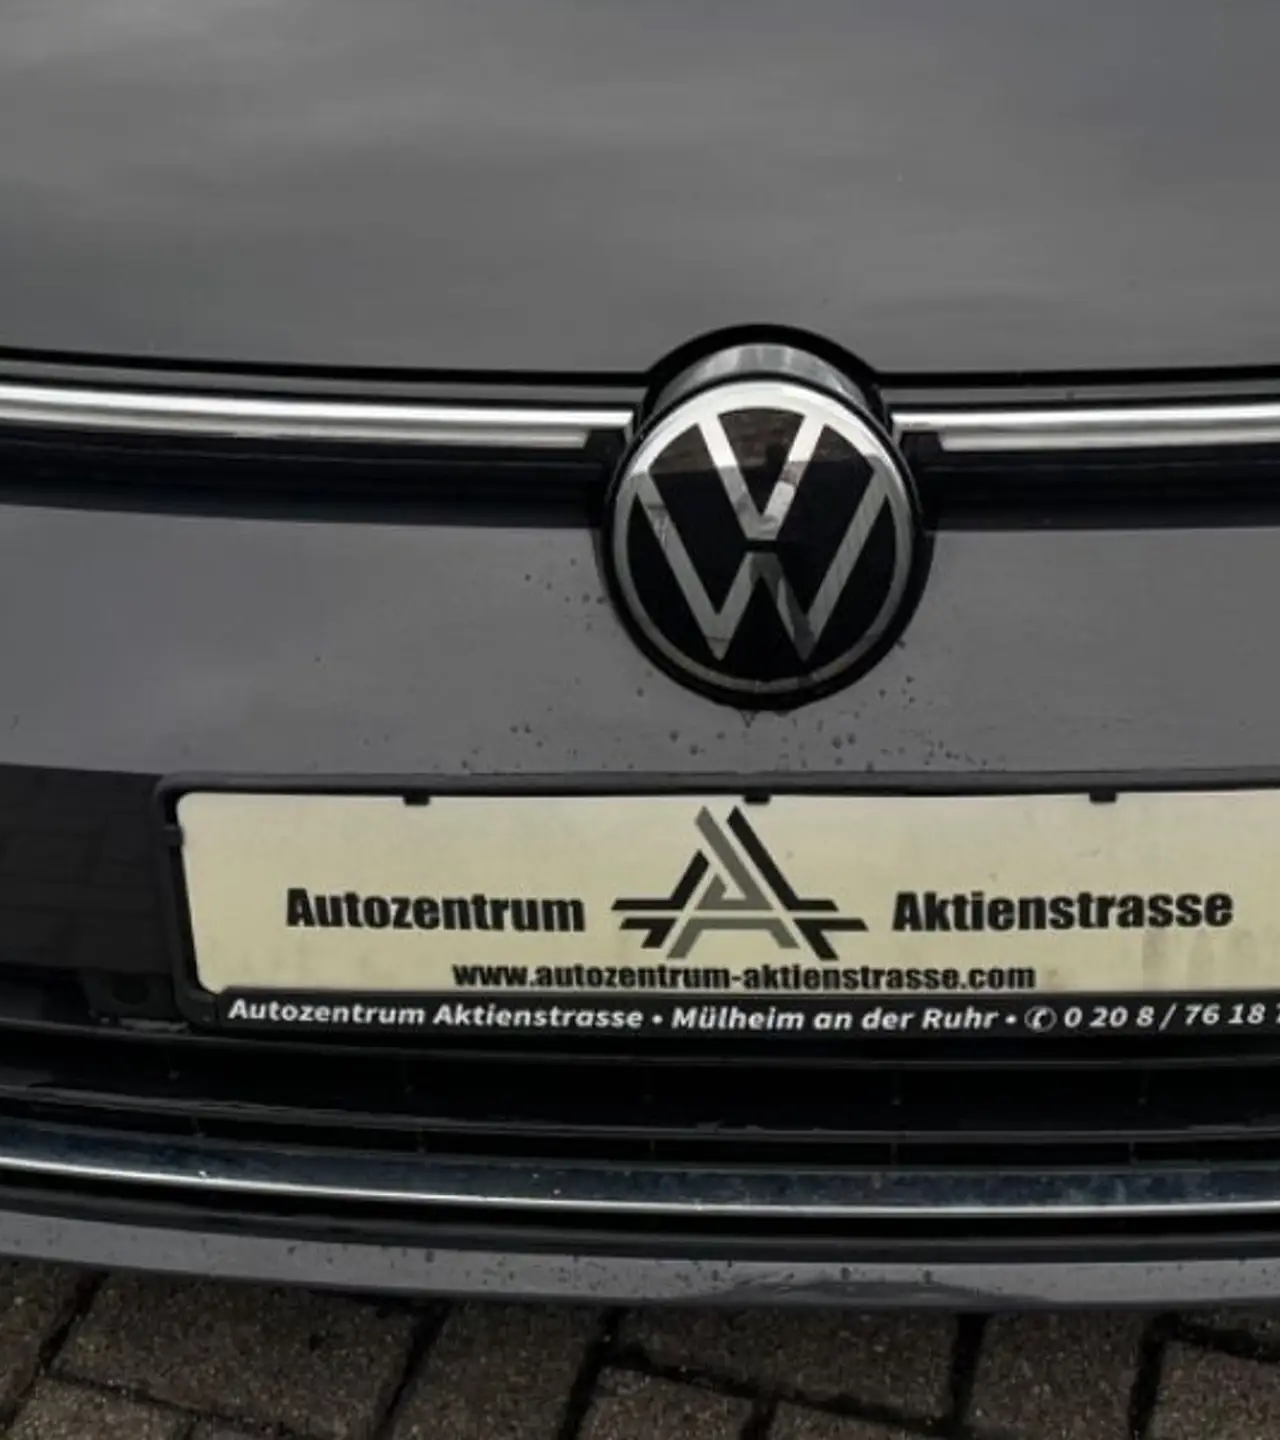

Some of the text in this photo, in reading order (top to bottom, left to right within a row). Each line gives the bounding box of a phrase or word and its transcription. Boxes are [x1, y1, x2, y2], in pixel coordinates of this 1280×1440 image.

[285, 887, 1234, 933] Autozentrum Aktienstrasse
[453, 962, 1036, 990] www.autozentrum-aktienstrasse.com
[227, 997, 426, 1026] Autozentrum
[432, 1002, 645, 1029] Aktienstrasse
[670, 1006, 805, 1030] Mülheim
[813, 1012, 853, 1030] an
[861, 1007, 914, 1030] der
[921, 1006, 999, 1030] Ruhr
[1064, 1006, 1083, 1028] 0
[1089, 1006, 1128, 1028] 20
[1185, 1003, 1220, 1026] 76
[1227, 1002, 1266, 1025] 18
